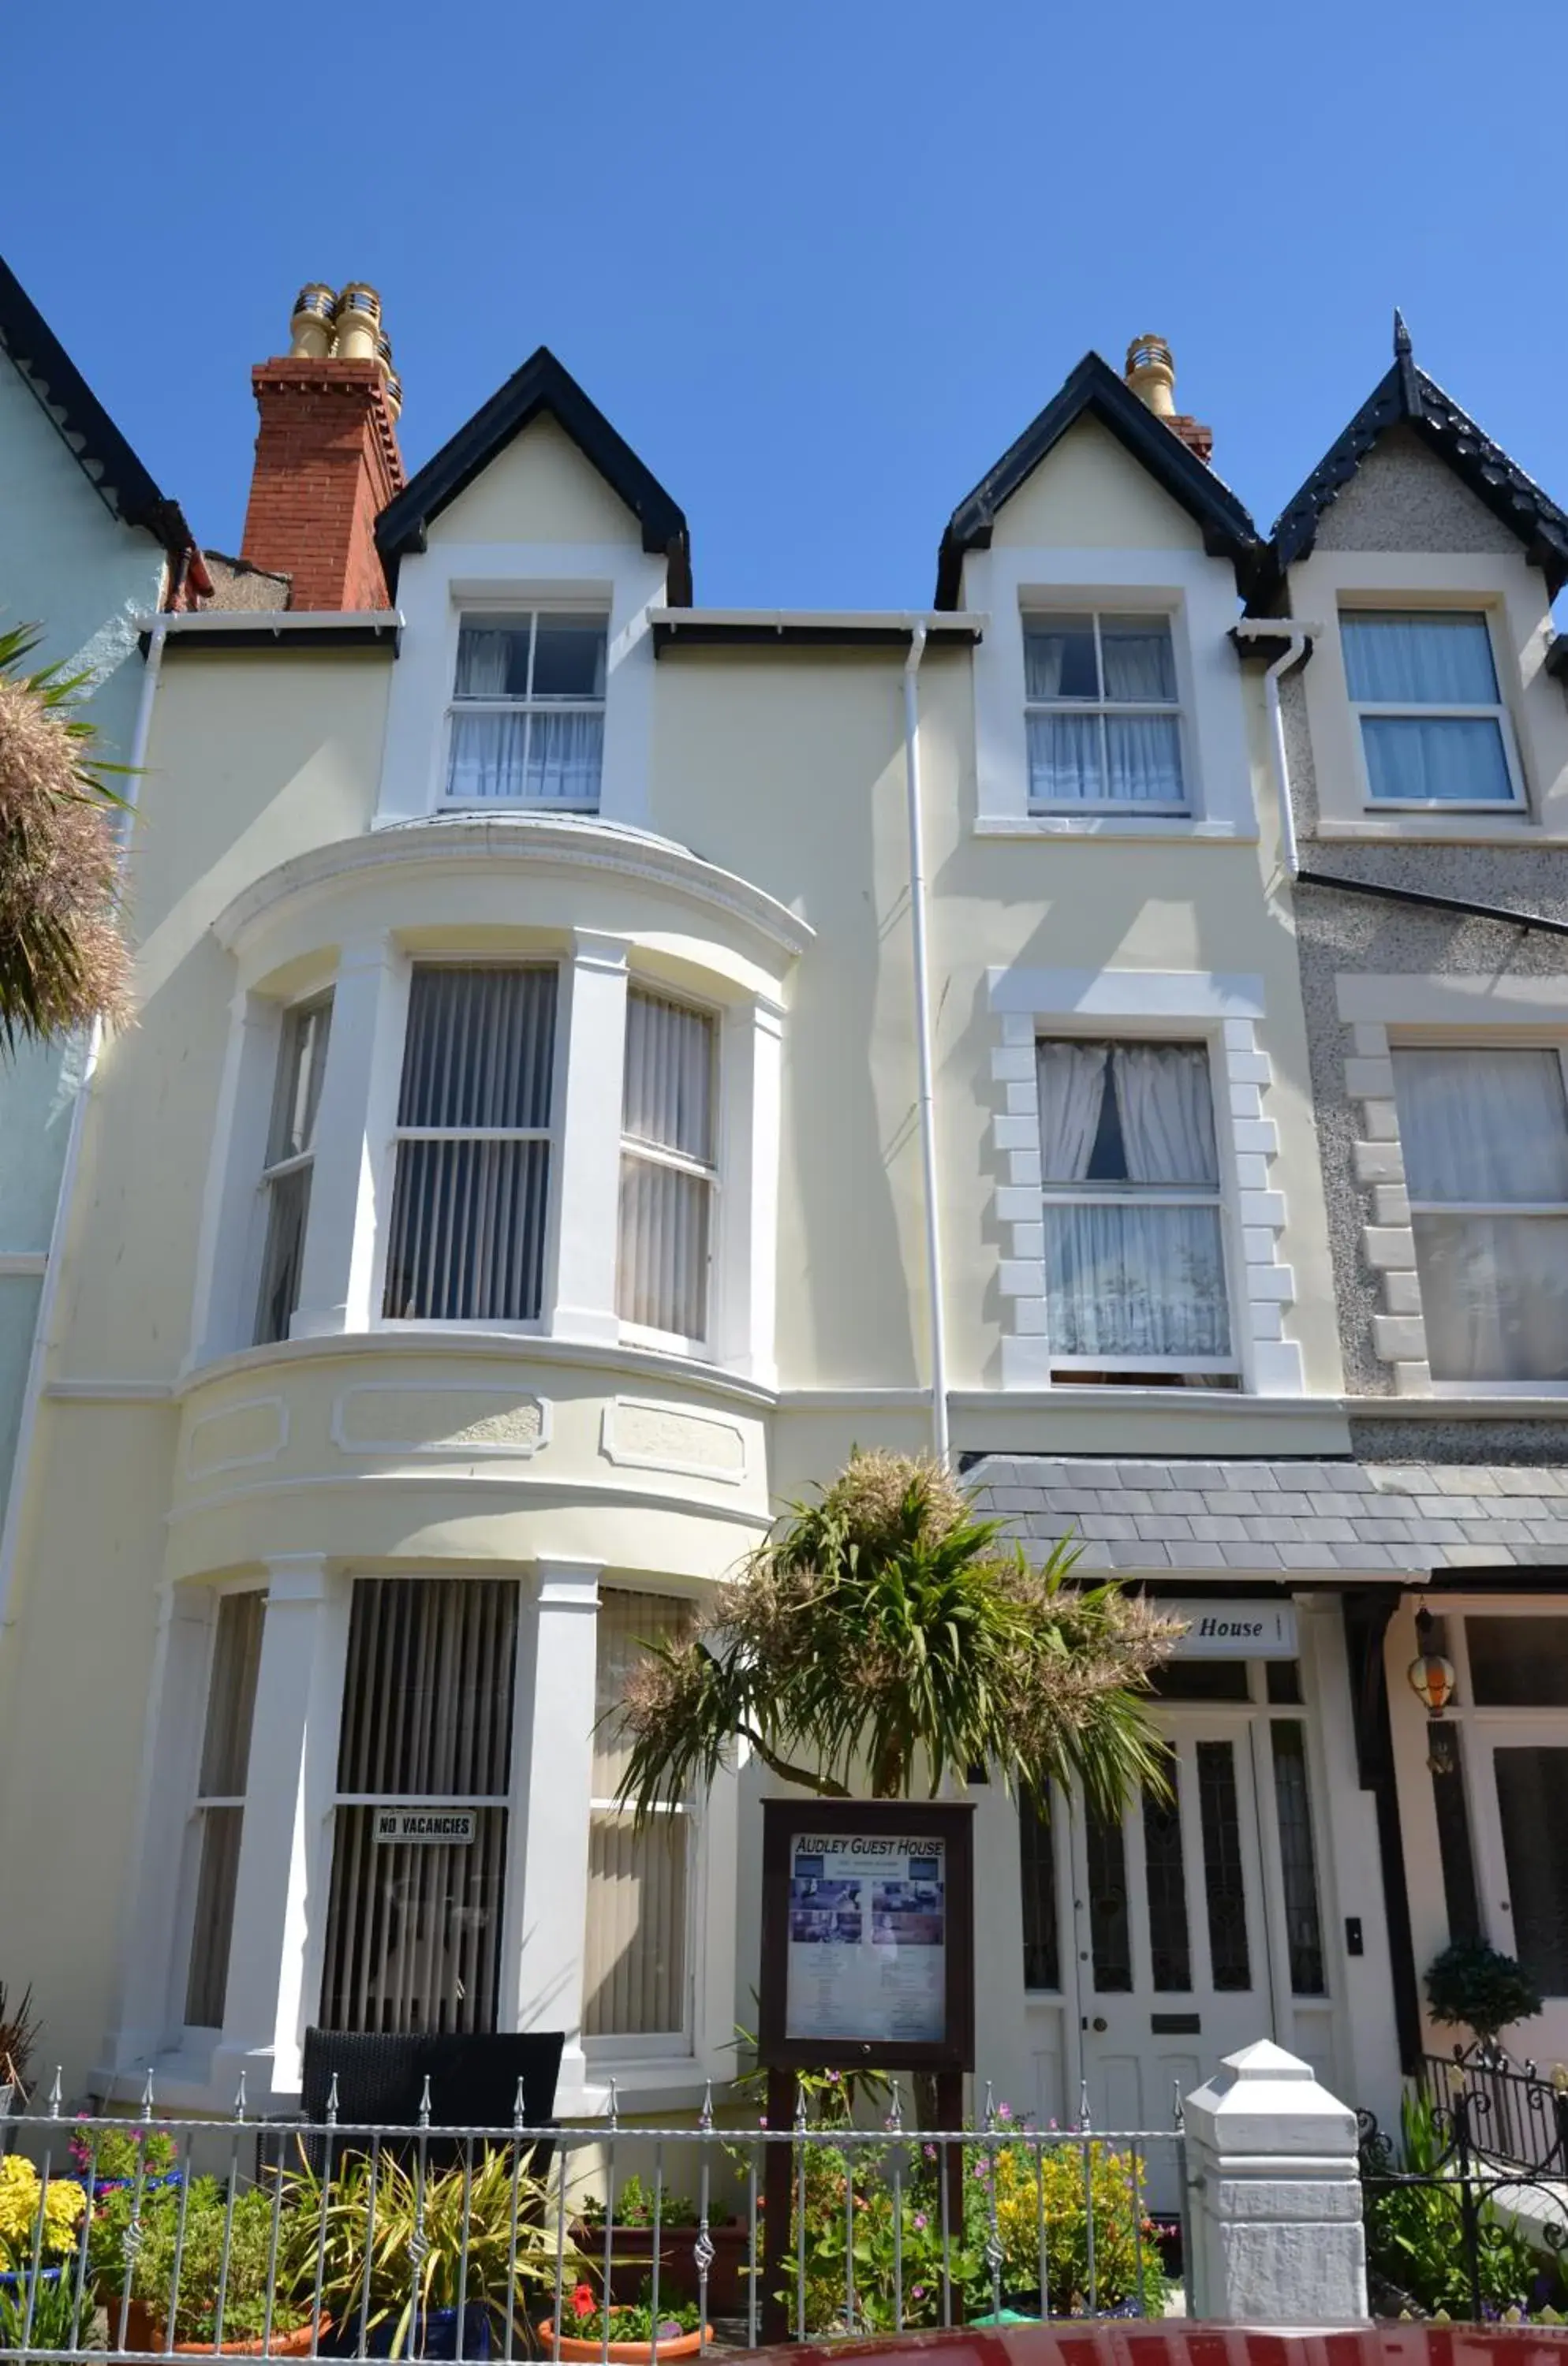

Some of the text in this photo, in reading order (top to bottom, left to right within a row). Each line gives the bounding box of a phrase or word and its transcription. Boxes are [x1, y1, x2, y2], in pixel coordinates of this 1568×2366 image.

[1199, 1618, 1264, 1637] House
[379, 1817, 470, 1834] NO VACANCIES
[796, 1836, 944, 1856] AUDLEY GUEST HOUSE
